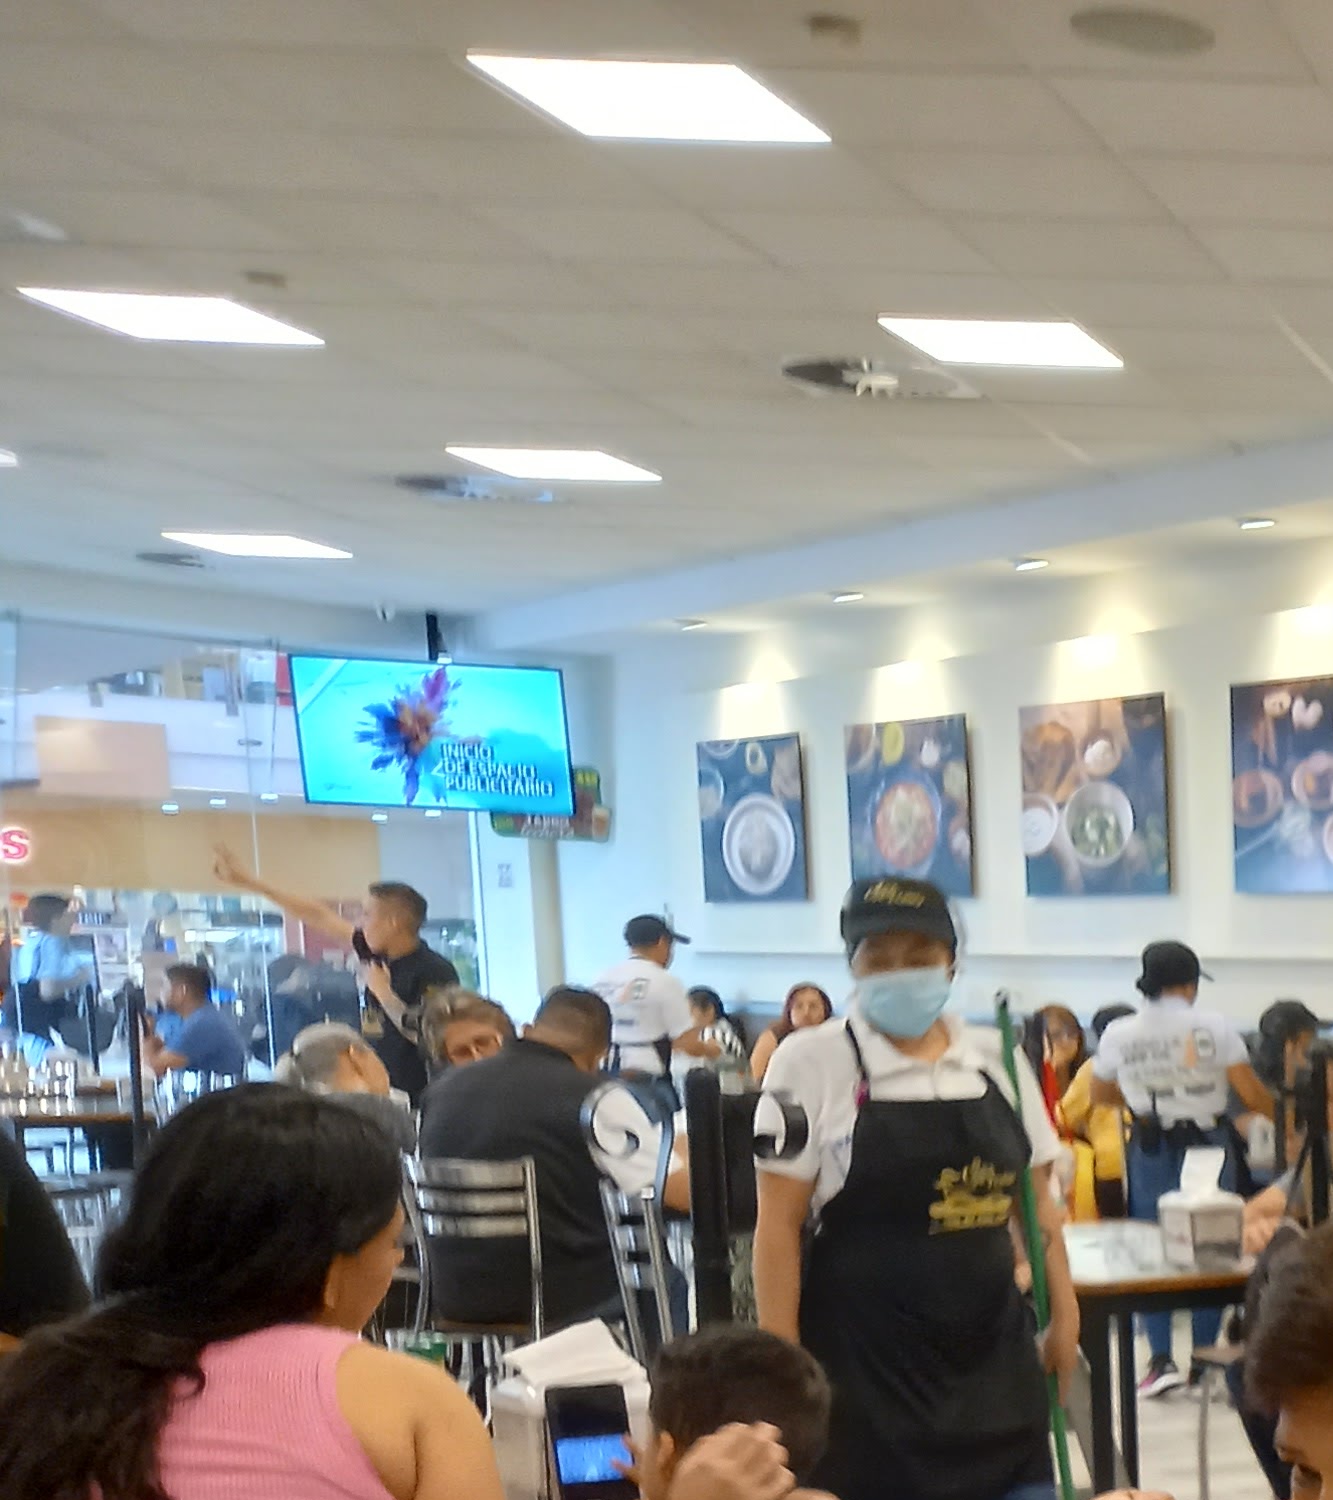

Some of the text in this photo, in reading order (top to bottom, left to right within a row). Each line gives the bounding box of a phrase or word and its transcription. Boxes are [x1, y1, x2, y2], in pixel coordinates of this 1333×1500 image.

[442, 743, 493, 760] INICIO
[443, 758, 537, 780] DE ESPACIO
[445, 775, 555, 797] PUBLICITARIO
